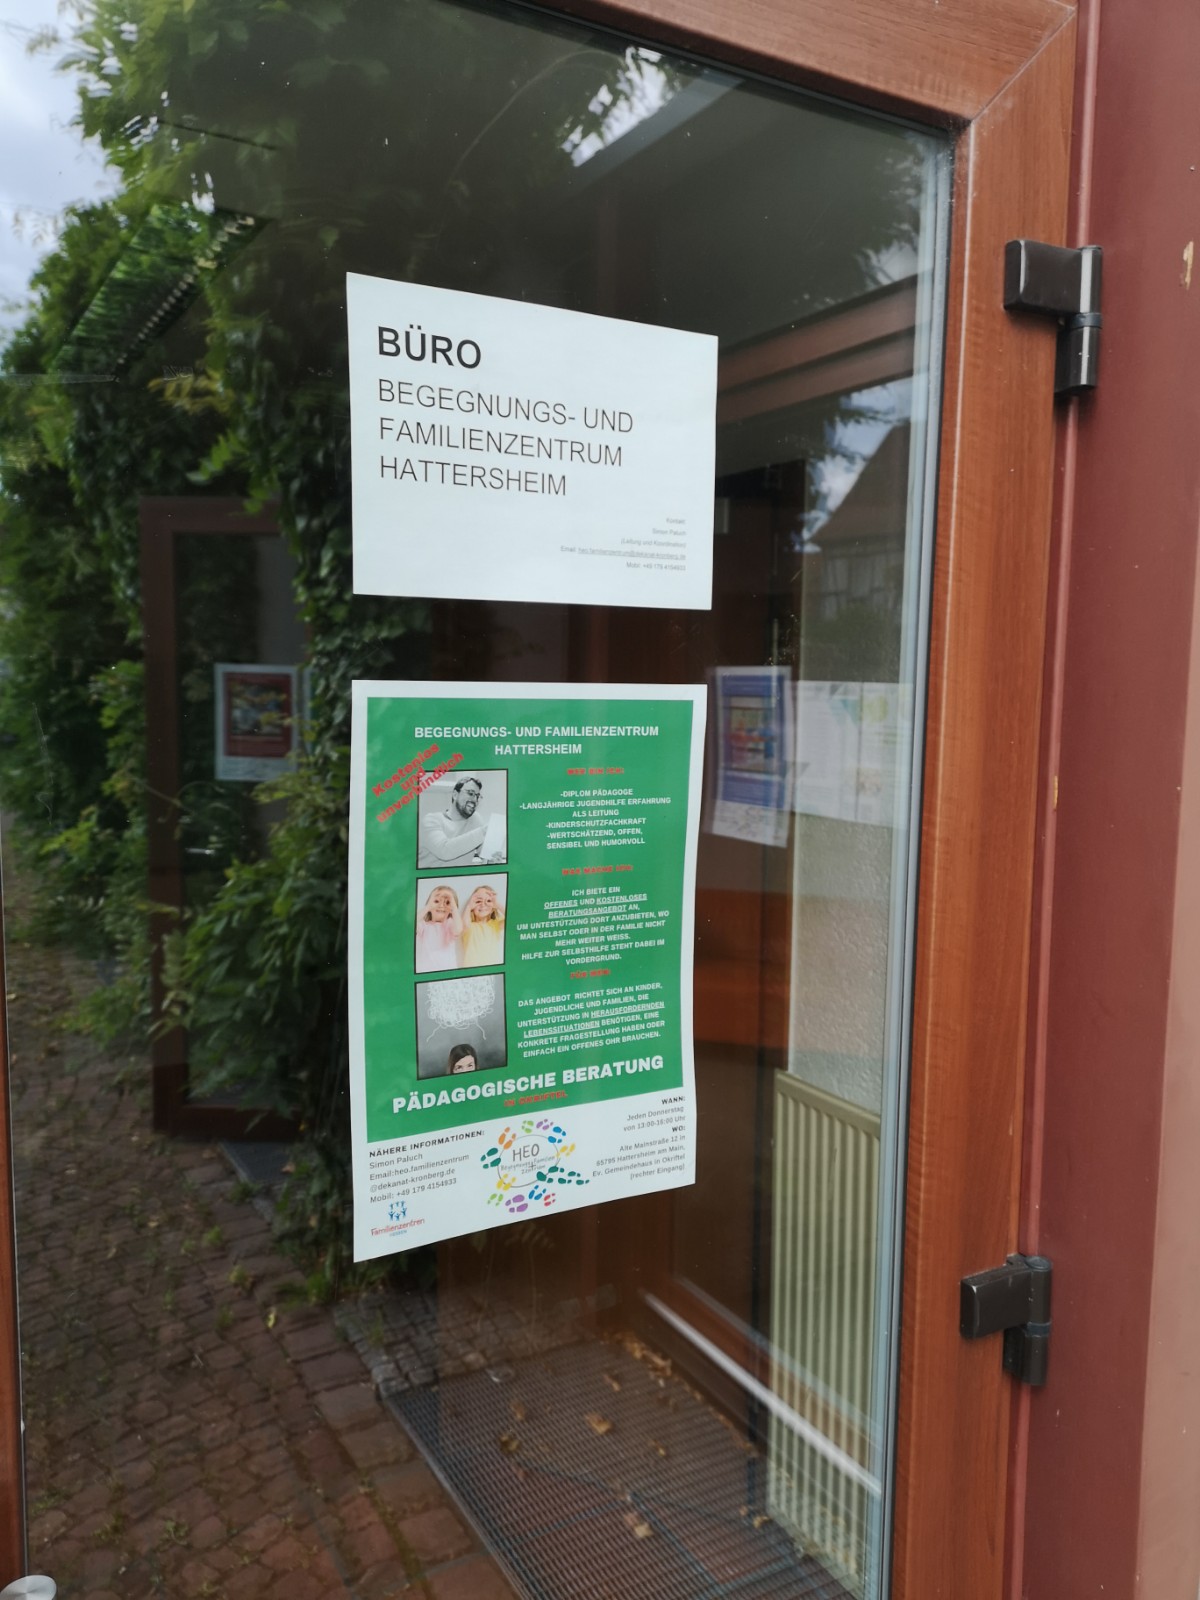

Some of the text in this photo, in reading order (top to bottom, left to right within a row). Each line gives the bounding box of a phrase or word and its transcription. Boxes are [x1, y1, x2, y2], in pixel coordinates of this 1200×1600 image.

[378, 324, 481, 369] BÜRO
[379, 379, 633, 433] BEGEGNUNGS- UND
[380, 418, 622, 467] FAMILIENZENTRUM
[380, 456, 566, 496] HATTERSHEIM
[414, 726, 659, 738] BEGEGNUNGS- UND FAMILIENZENTRUM
[495, 743, 582, 755] HATTERSHEIM
[372, 743, 439, 797] Kostenlos
[400, 767, 426, 792] und
[376, 753, 464, 823] unverbindlich
[593, 788, 633, 796] PÄDAGOGE
[520, 797, 671, 809] -LANGJÄHRIGE JUGENDHILFE ERFAHRUNG
[546, 818, 646, 828] -KINDERSCHUTZFACHKRAFT
[547, 829, 616, 839] -WERTSCHÄTZEND,
[602, 838, 645, 846] HUMORVOLL
[544, 900, 578, 909] OFFENES
[597, 894, 647, 905] KOSTENLOSES
[548, 904, 627, 918] BERATUNGSANGEBOT
[539, 930, 567, 938] SELBST
[569, 928, 589, 936] ODER
[600, 925, 614, 933] DER
[616, 922, 643, 931] FAMILIE
[645, 920, 666, 928] NICHT
[578, 936, 605, 944] WEITER
[522, 952, 543, 960] HILFE
[545, 950, 560, 958] ZUR
[562, 945, 609, 956] SELBSTHILFE
[611, 942, 633, 950] STEHT
[635, 940, 655, 948] DABEI
[566, 953, 622, 965] VORDERGRUND.
[518, 999, 534, 1007] DAS
[536, 994, 571, 1005] ANGEBOT
[575, 990, 604, 999] RICHTET
[606, 987, 623, 995] SICH
[534, 1002, 584, 1015] JUGENDLICHE
[603, 996, 636, 1006] FAMILIEN,
[517, 1013, 580, 1028] UNTERSTÜTZUNG
[591, 1001, 665, 1018] HERAUSFORDERNDEN
[518, 1020, 665, 1048] KONKRETE FRAGESTELLUNG HABEN ODER
[524, 1020, 600, 1038] LEBENSSITUATIONEN
[644, 1011, 659, 1019] EINE
[524, 1047, 556, 1058] EINFACH
[571, 1040, 604, 1050] OFFENES
[605, 1037, 620, 1045] OHR
[622, 1031, 661, 1042] BRAUCHEN.
[392, 1055, 664, 1114] PÄDAGOGISCHE BERATUNG
[662, 1096, 685, 1104] WANN:
[627, 1106, 684, 1121] Jeden Donnerstag
[624, 1124, 636, 1132] von
[369, 1130, 485, 1158] NÄHERE INFORMATIONEN:
[512, 1143, 540, 1162] HEO
[634, 1138, 669, 1148] Mainstraße
[370, 1153, 423, 1169] Simon Paluch
[370, 1154, 469, 1181] Email:heo.familienzentrum
[596, 1157, 616, 1166] 65795
[617, 1150, 656, 1162] Hattersheim
[605, 1160, 653, 1174] Gemeindehaus
[662, 1153, 685, 1163] Okriftel
[370, 1168, 455, 1193] @dekanat-kronberg.de
[370, 1177, 457, 1203] Mobil: +49 179 4154933
[371, 1217, 425, 1236] Familienzentren
